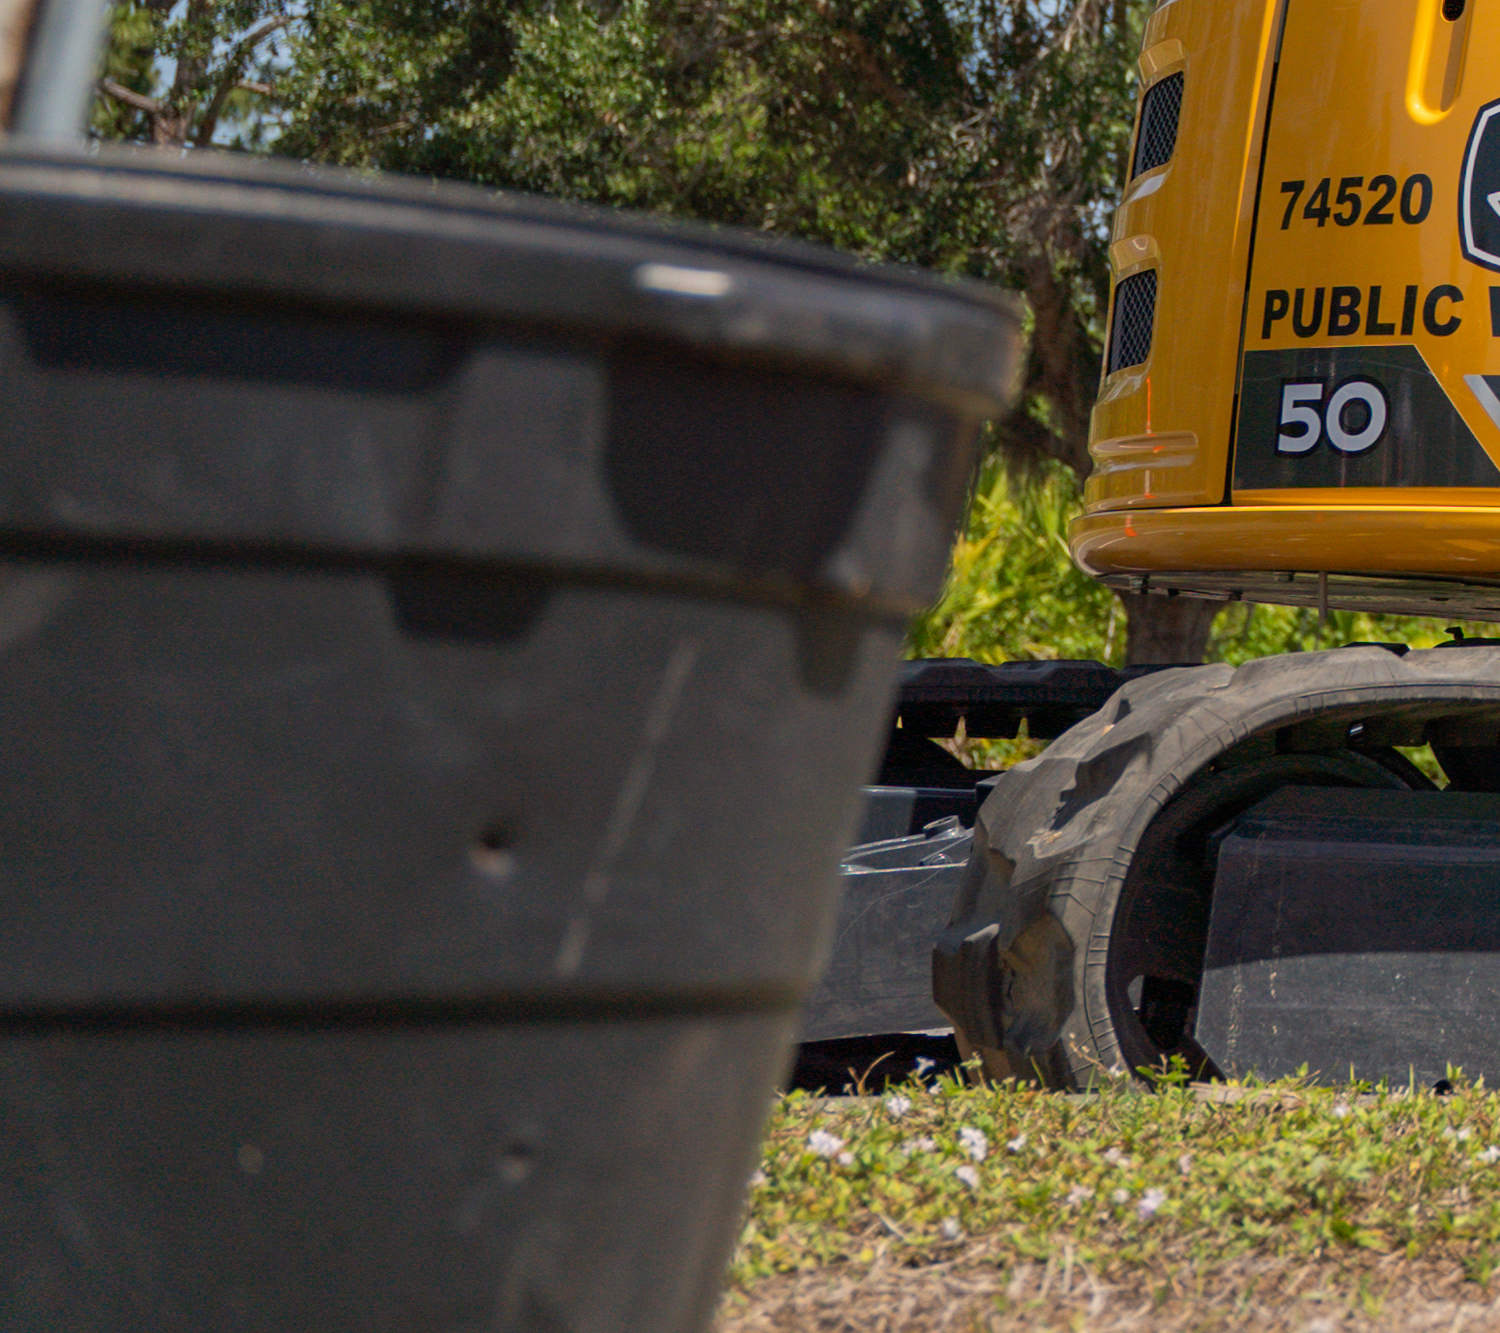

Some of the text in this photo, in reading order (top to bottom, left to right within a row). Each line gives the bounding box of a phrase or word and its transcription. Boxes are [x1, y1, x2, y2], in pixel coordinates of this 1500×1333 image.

[1280, 173, 1433, 230] 74520
[1261, 284, 1464, 339] PUBLIC
[1277, 381, 1387, 453] 50
